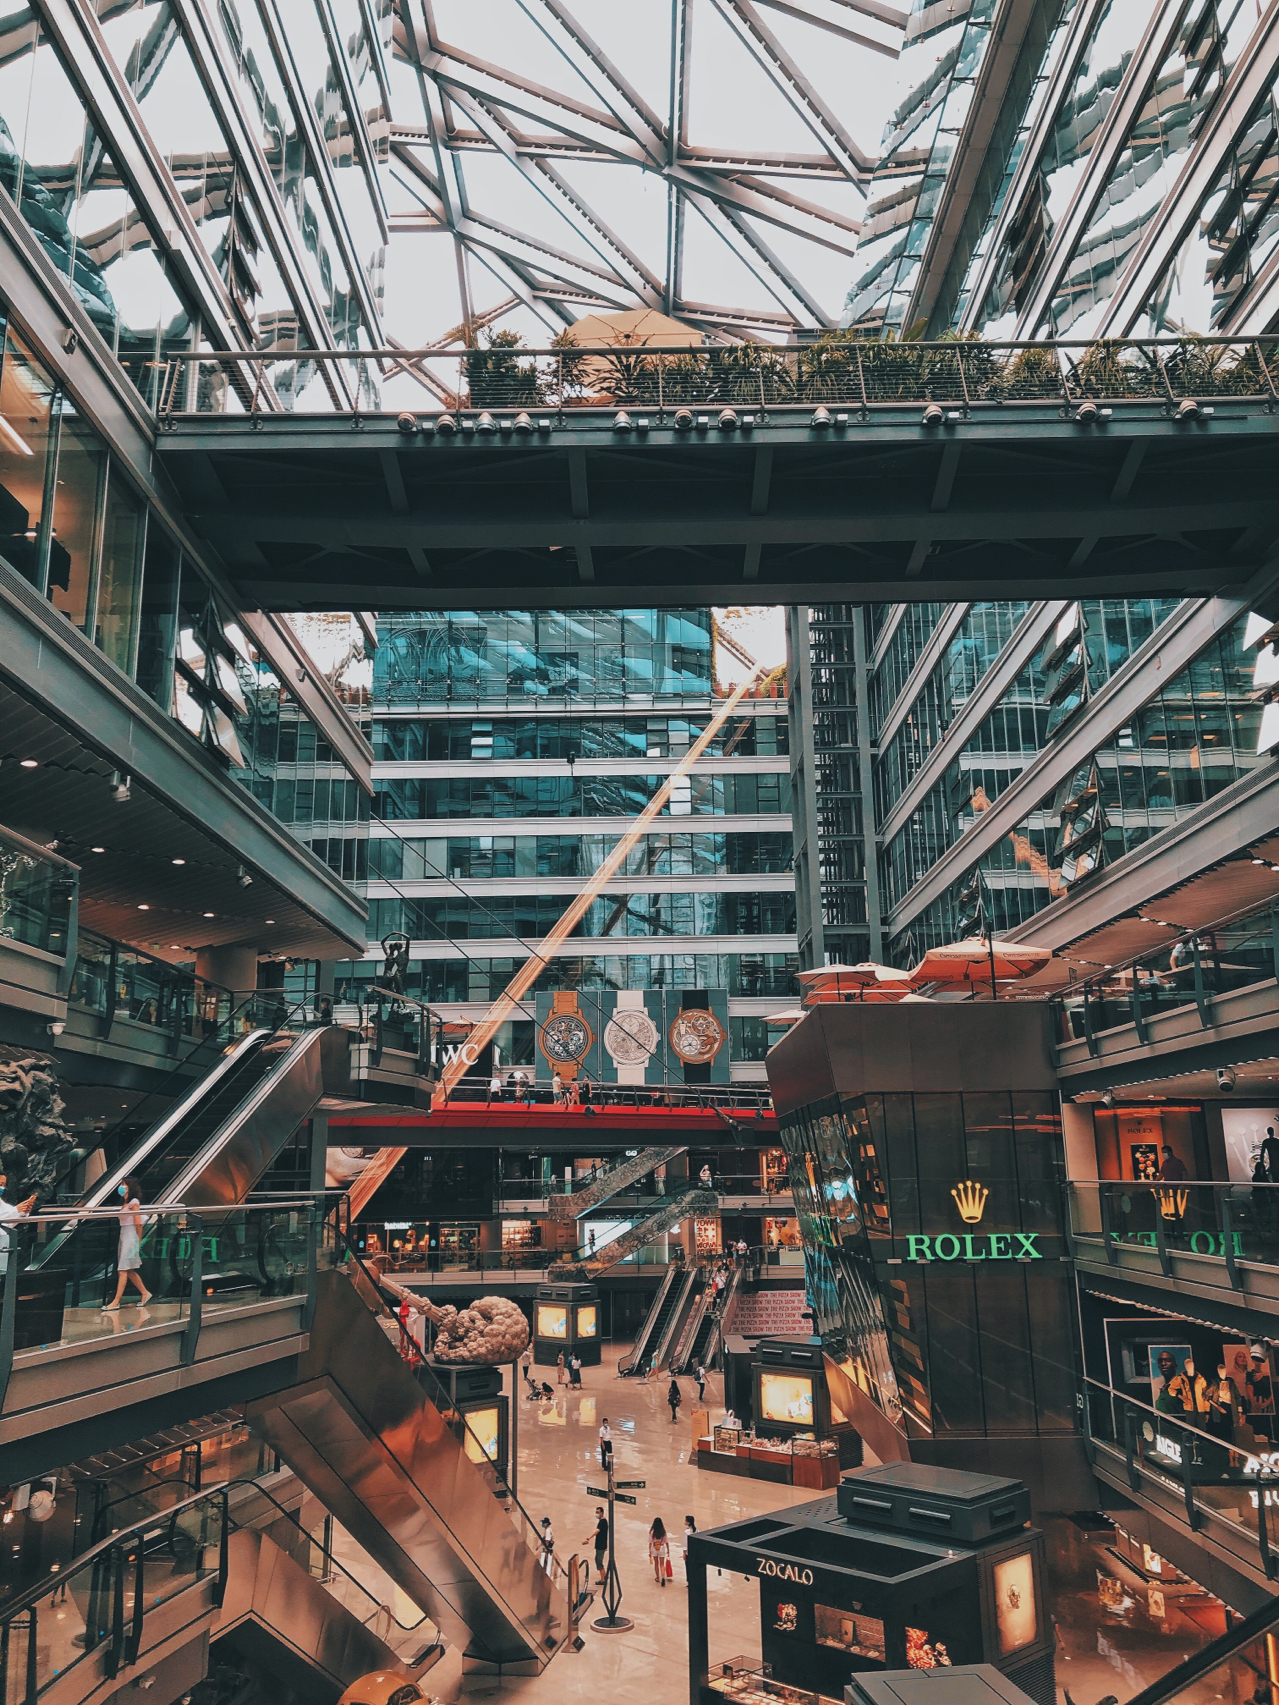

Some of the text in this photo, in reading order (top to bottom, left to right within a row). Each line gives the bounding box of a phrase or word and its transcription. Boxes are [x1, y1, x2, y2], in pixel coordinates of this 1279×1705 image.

[906, 1233, 1042, 1260] ROLEX
[1156, 1434, 1182, 1464] AIGLE
[756, 1558, 814, 1586] ZOCALO
